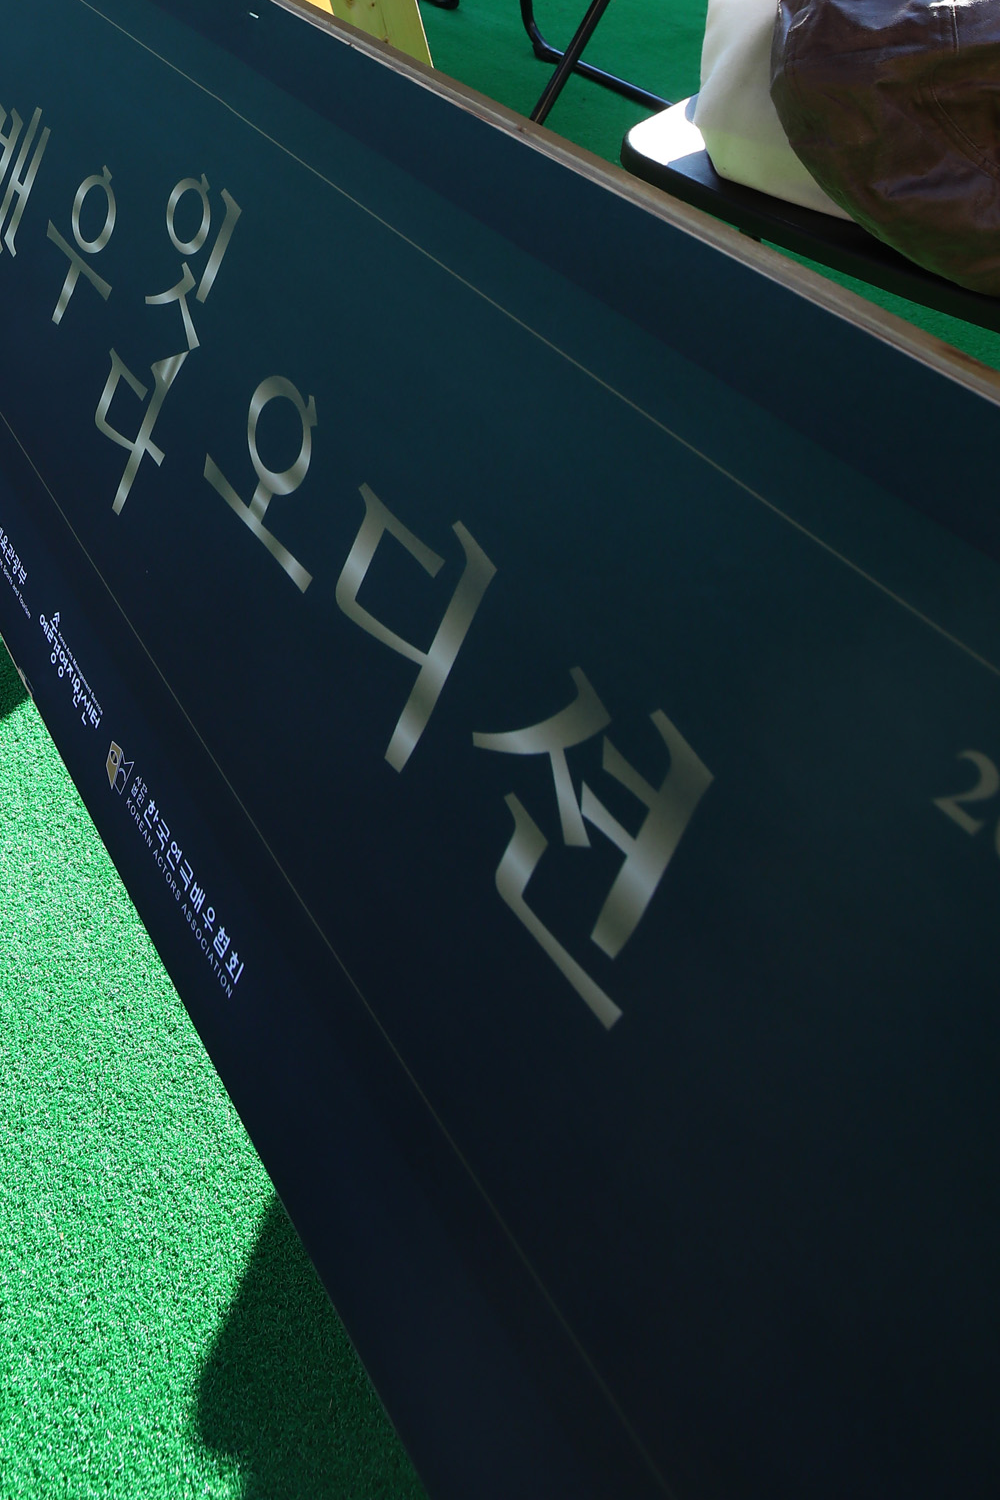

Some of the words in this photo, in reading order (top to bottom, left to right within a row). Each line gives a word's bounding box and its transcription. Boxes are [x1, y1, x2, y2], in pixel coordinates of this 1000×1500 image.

[94, 172, 243, 516] 잇다
[203, 374, 715, 1031] 오디션
[125, 796, 153, 848] KOREAN
[152, 848, 182, 902] ACTORS
[181, 903, 234, 1000] ASSOCIATION
[143, 799, 245, 985] 한국연극배우협회
[931, 749, 1000, 863] 2
